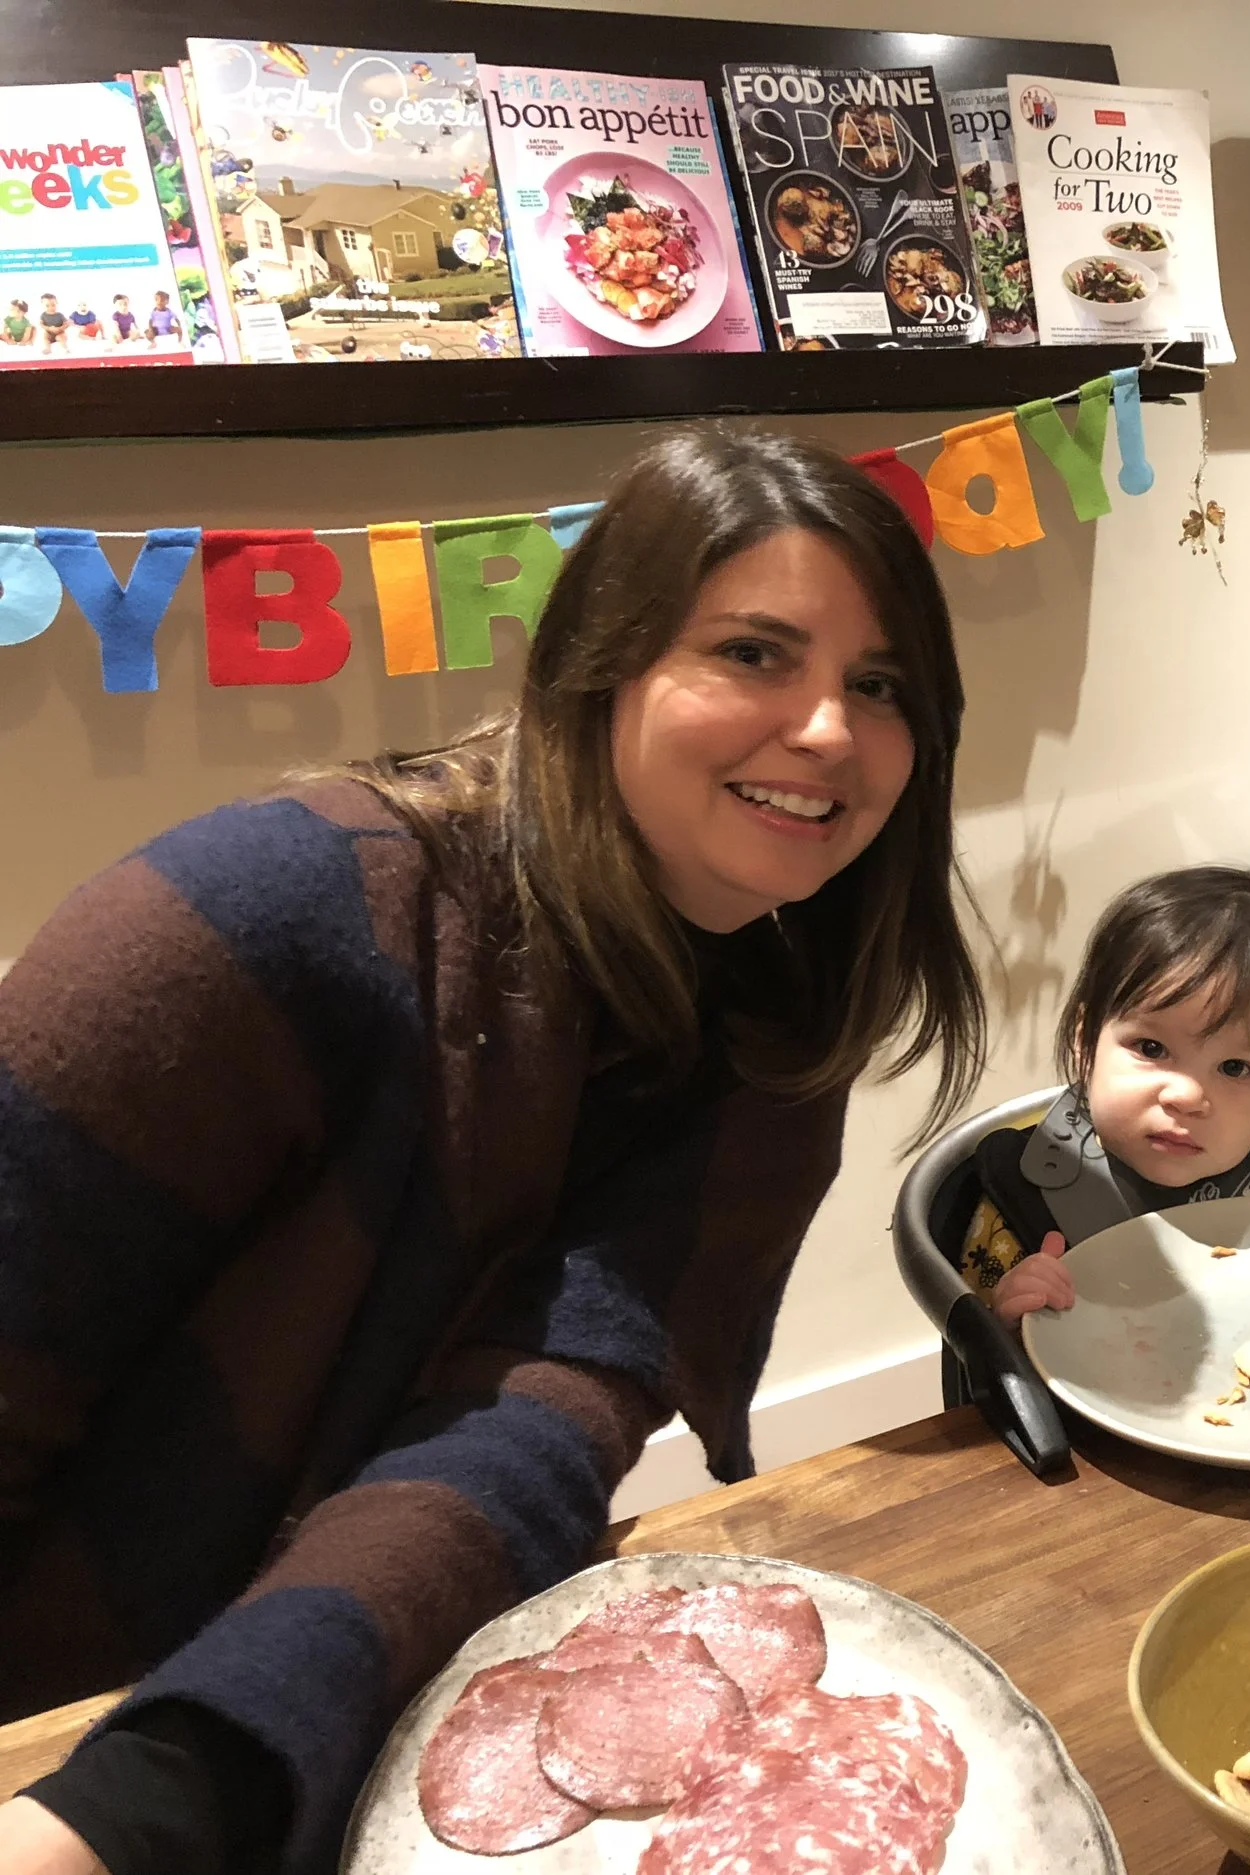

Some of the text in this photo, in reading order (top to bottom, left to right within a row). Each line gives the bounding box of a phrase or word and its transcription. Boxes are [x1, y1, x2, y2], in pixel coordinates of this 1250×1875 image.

[740, 66, 772, 74] SPECIAL
[773, 67, 800, 75] TRAVEL
[733, 74, 934, 107] FOOD & WINE
[490, 90, 709, 144] bon appétit
[752, 108, 939, 169] SPAIN
[0, 138, 126, 173] wonder
[1047, 134, 1178, 186] Cooking
[1053, 177, 1152, 215] for Two
[1056, 201, 1083, 212] 2009
[776, 276, 810, 284] SPANISH
[778, 283, 803, 291] WINES
[918, 292, 978, 325] 298
[896, 325, 933, 334] REASONS
[935, 325, 946, 333] TO
[947, 324, 959, 332] GO
